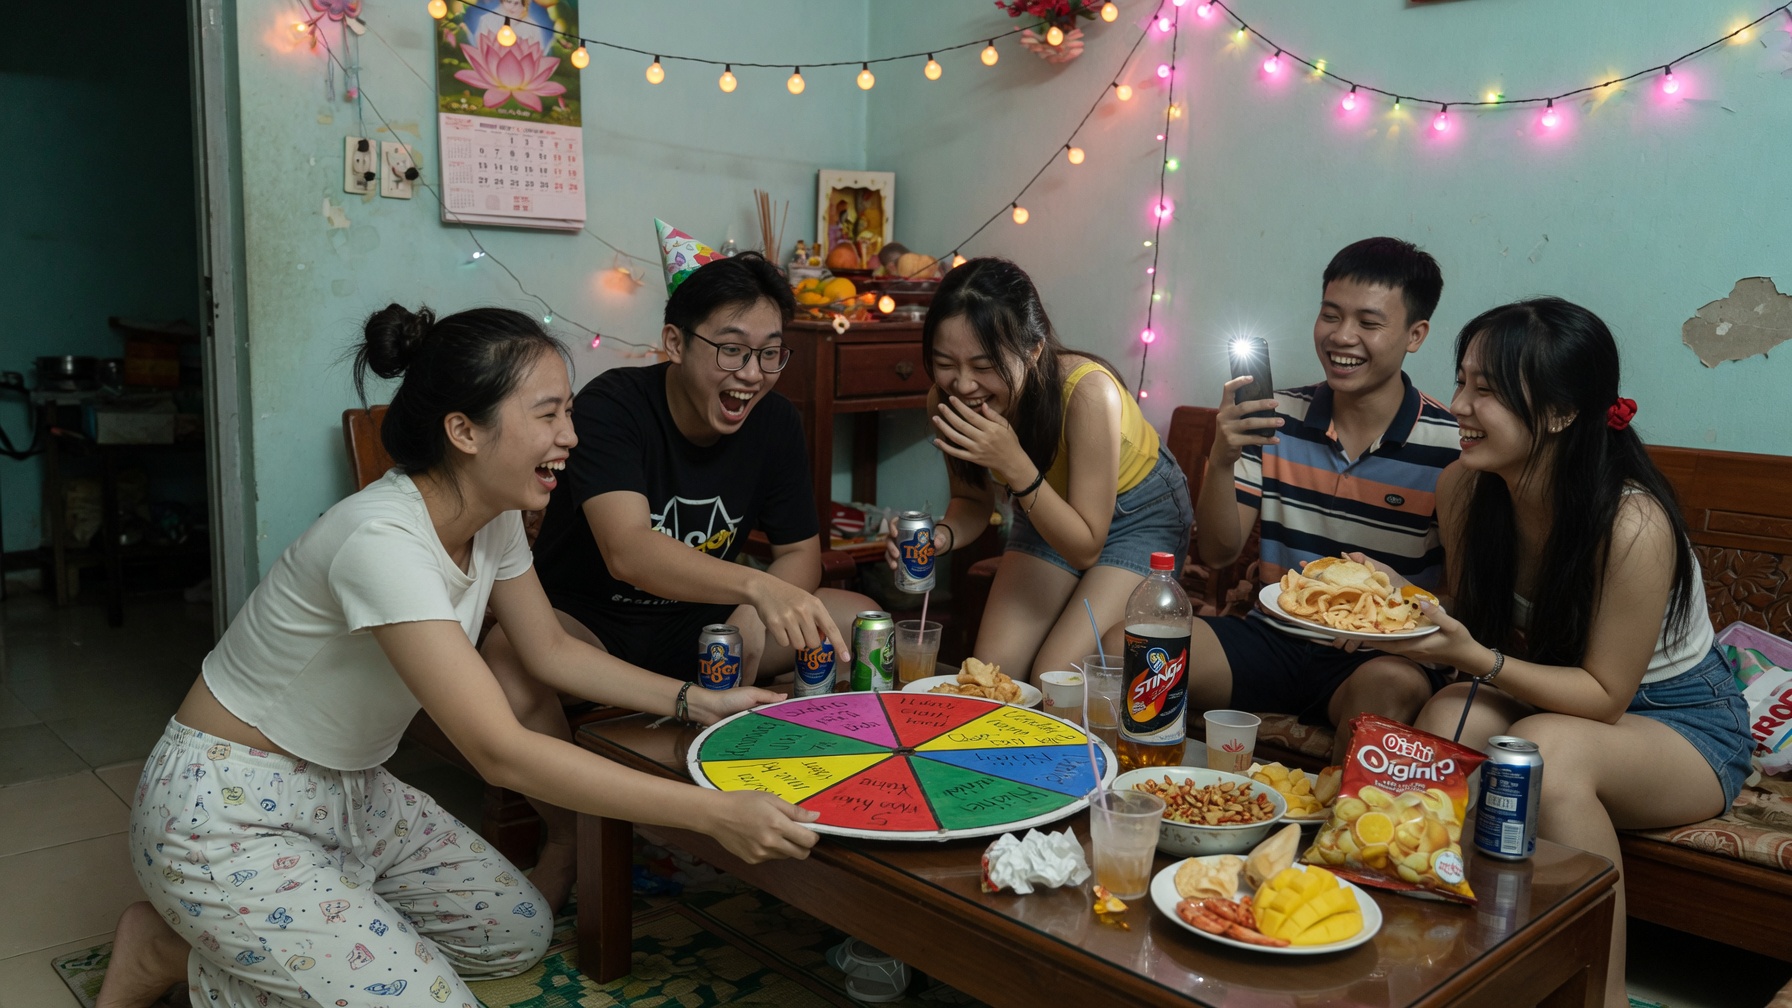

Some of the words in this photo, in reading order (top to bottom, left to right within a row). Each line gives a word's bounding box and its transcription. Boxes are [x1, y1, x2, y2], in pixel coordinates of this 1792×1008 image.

[699, 658, 739, 683] Tiger
[797, 648, 834, 671] Tiger
[1382, 733, 1435, 763] Oishi
